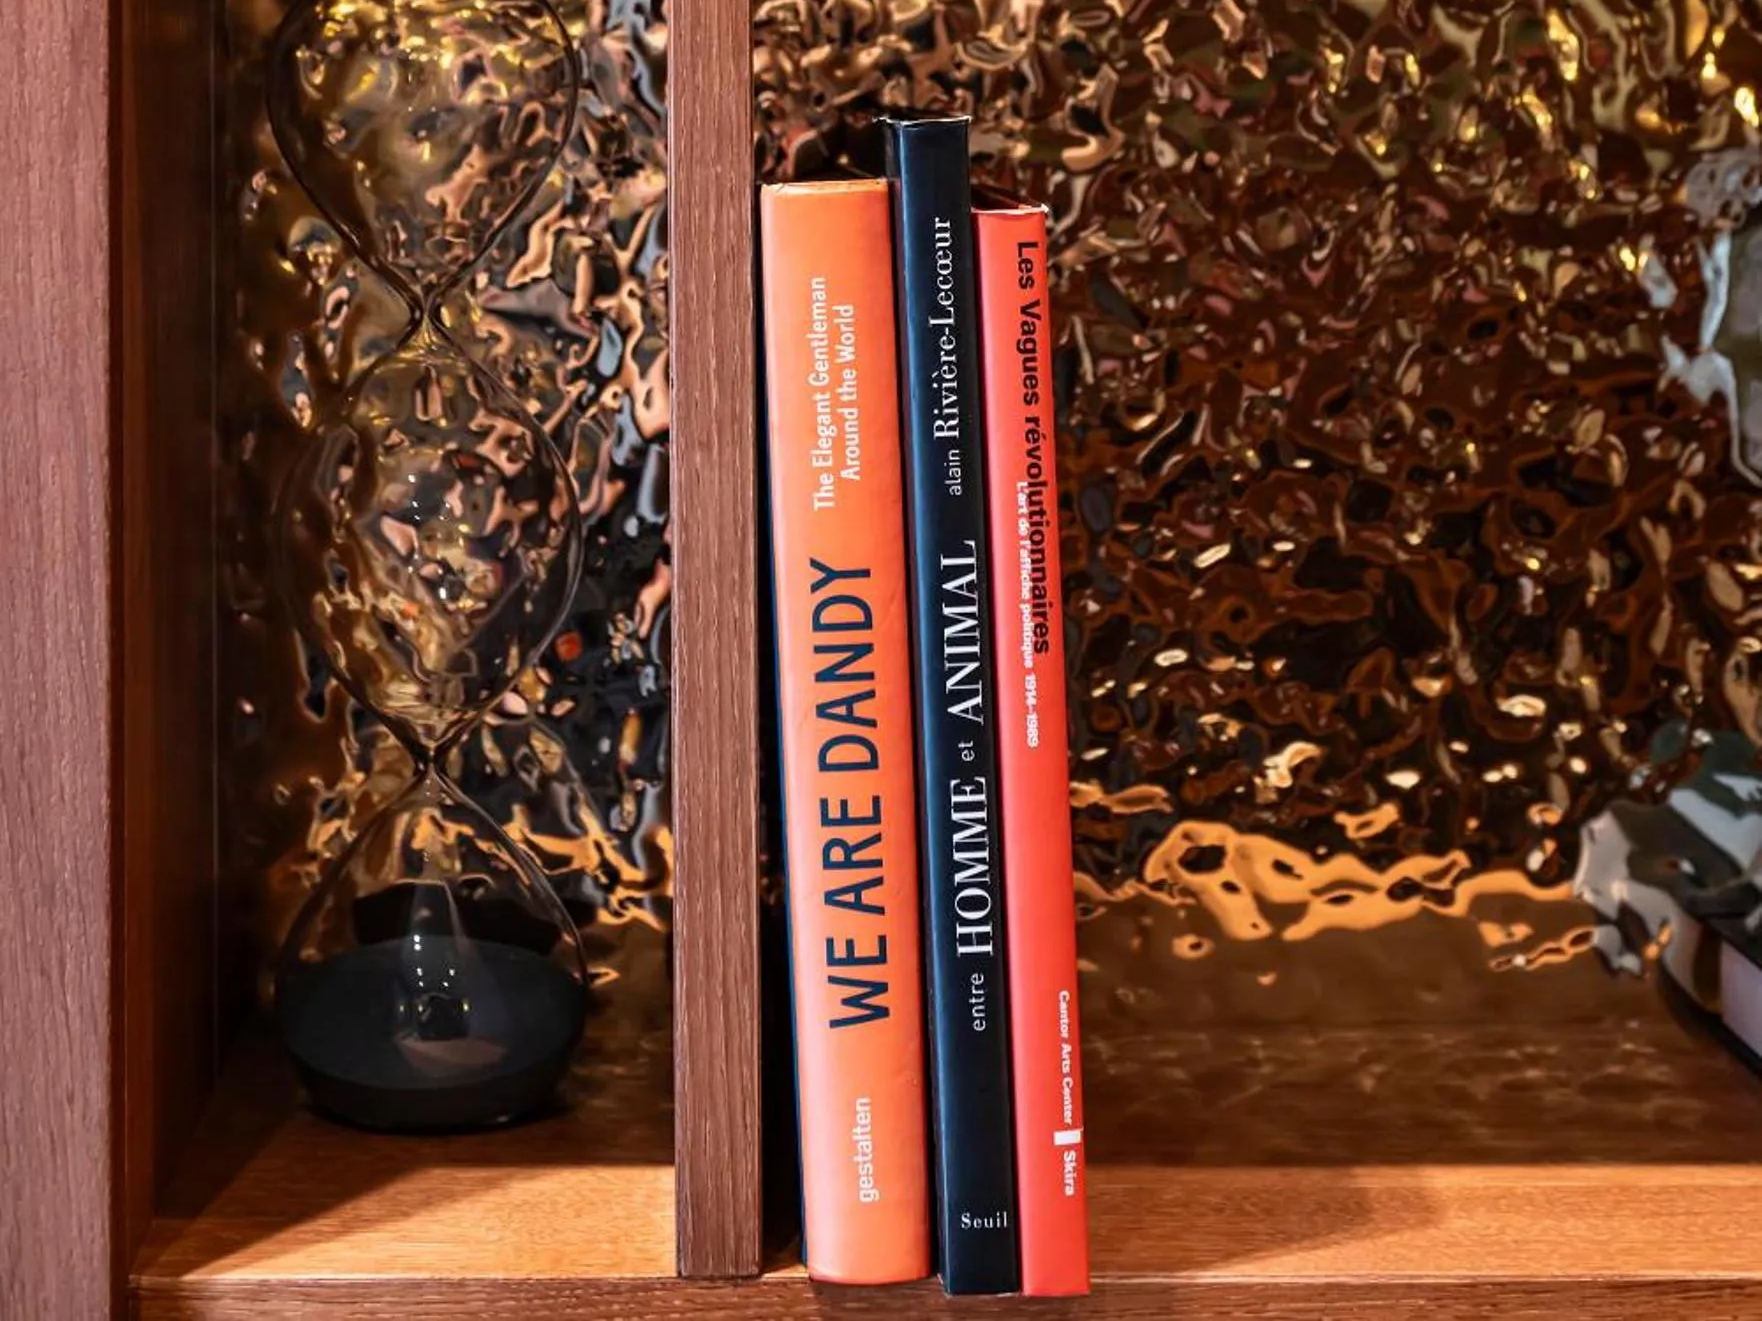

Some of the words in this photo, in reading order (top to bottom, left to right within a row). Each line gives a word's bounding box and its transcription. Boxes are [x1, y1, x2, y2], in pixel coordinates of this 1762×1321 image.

[1016, 241, 1039, 290] Les
[806, 277, 830, 387] Gentleman
[832, 304, 856, 365] World
[928, 217, 960, 440] Rivière-Lecœur
[1016, 299, 1042, 406] Vagues
[836, 368, 858, 403] the
[811, 392, 838, 467] Elegant
[836, 407, 861, 481] Around
[812, 473, 835, 510] The
[944, 449, 963, 496] alain
[1017, 517, 1030, 537] de
[1024, 416, 1054, 656] révolutionnaires
[940, 539, 984, 726] ANIMAL
[809, 557, 880, 772] DANDY
[958, 740, 975, 762] et
[820, 795, 886, 916] ARE
[950, 776, 994, 958] HOMME
[825, 934, 890, 1029] WE
[968, 972, 987, 1031] entre
[1058, 989, 1071, 1039] Cantor
[1060, 1043, 1073, 1074] Arts
[1062, 1076, 1075, 1126] Center
[852, 1096, 880, 1203] gestalten
[1063, 1149, 1078, 1197] Skira
[960, 1211, 1008, 1229] Seuil
